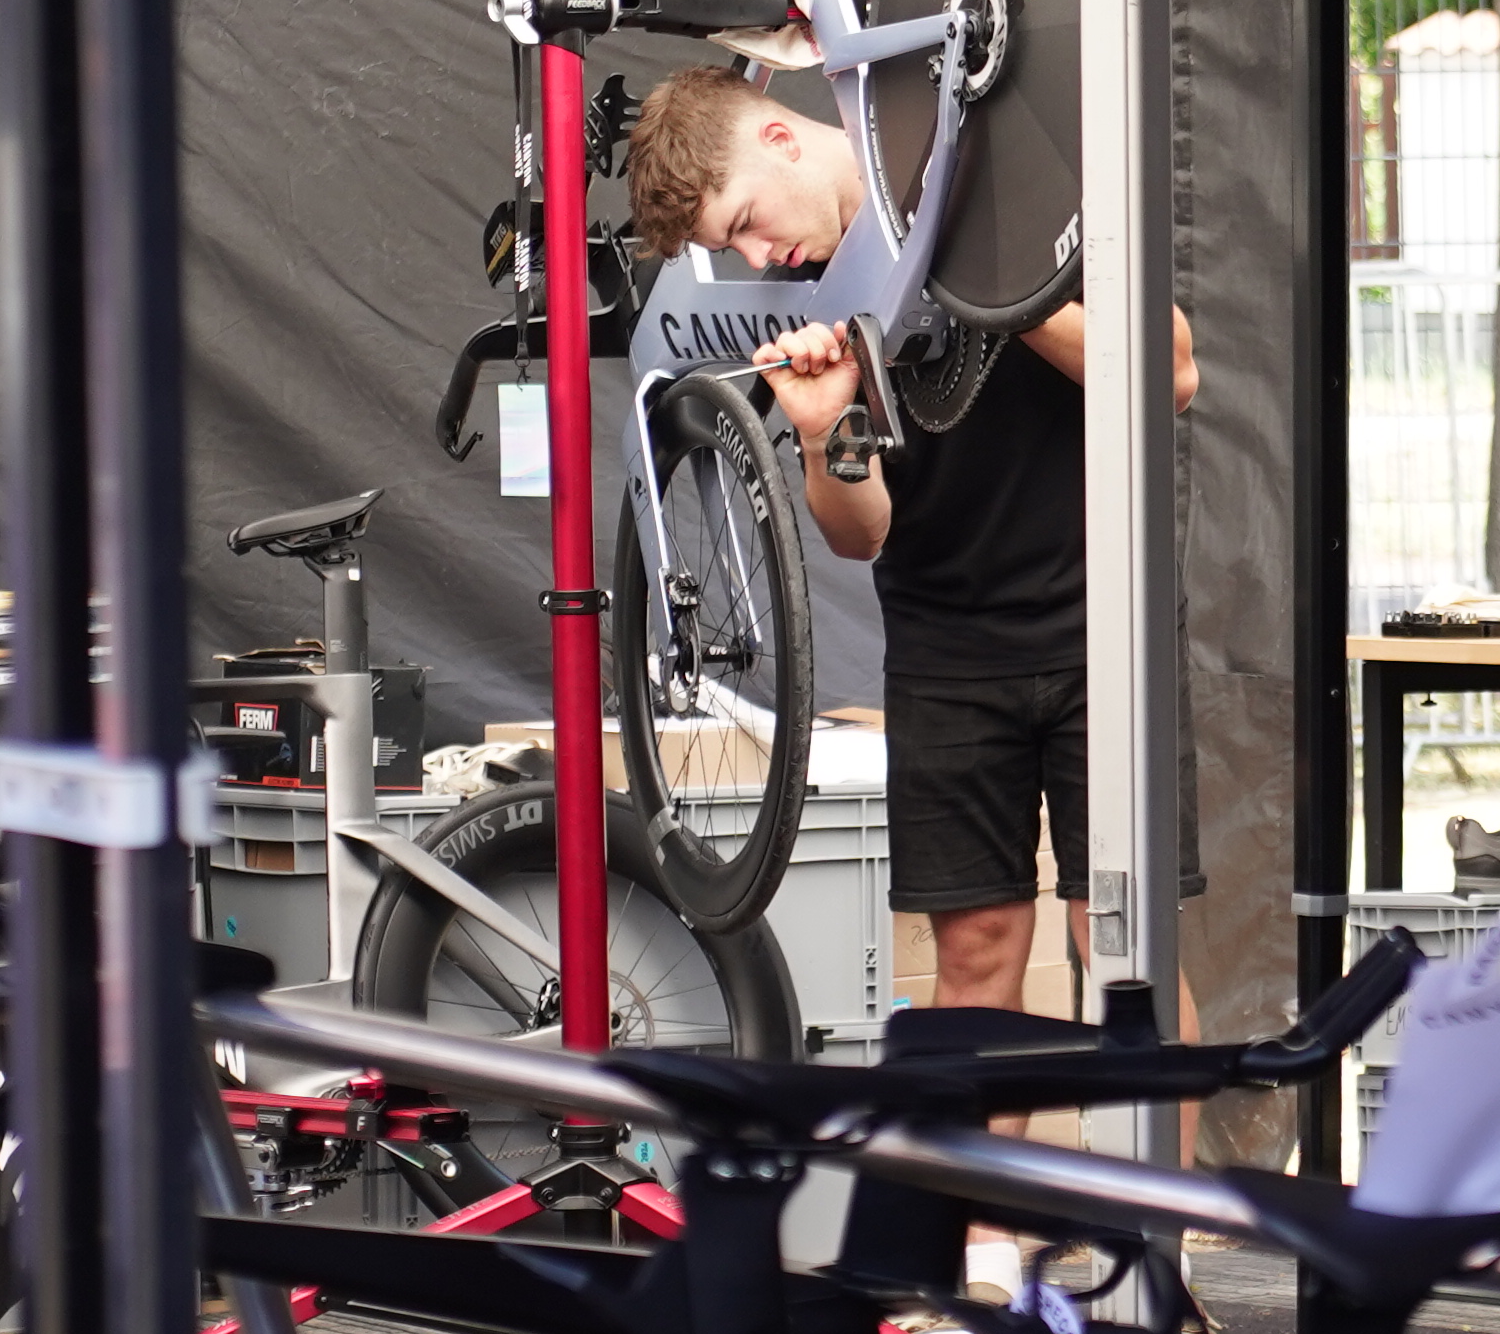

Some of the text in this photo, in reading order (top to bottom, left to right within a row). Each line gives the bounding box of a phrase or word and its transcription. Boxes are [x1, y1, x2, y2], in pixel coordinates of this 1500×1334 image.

[1054, 212, 1079, 270] DT
[660, 313, 806, 359] CANYO
[714, 411, 770, 525] SWISS DT
[239, 709, 273, 731] FERM
[430, 800, 542, 868] DT SWIS
